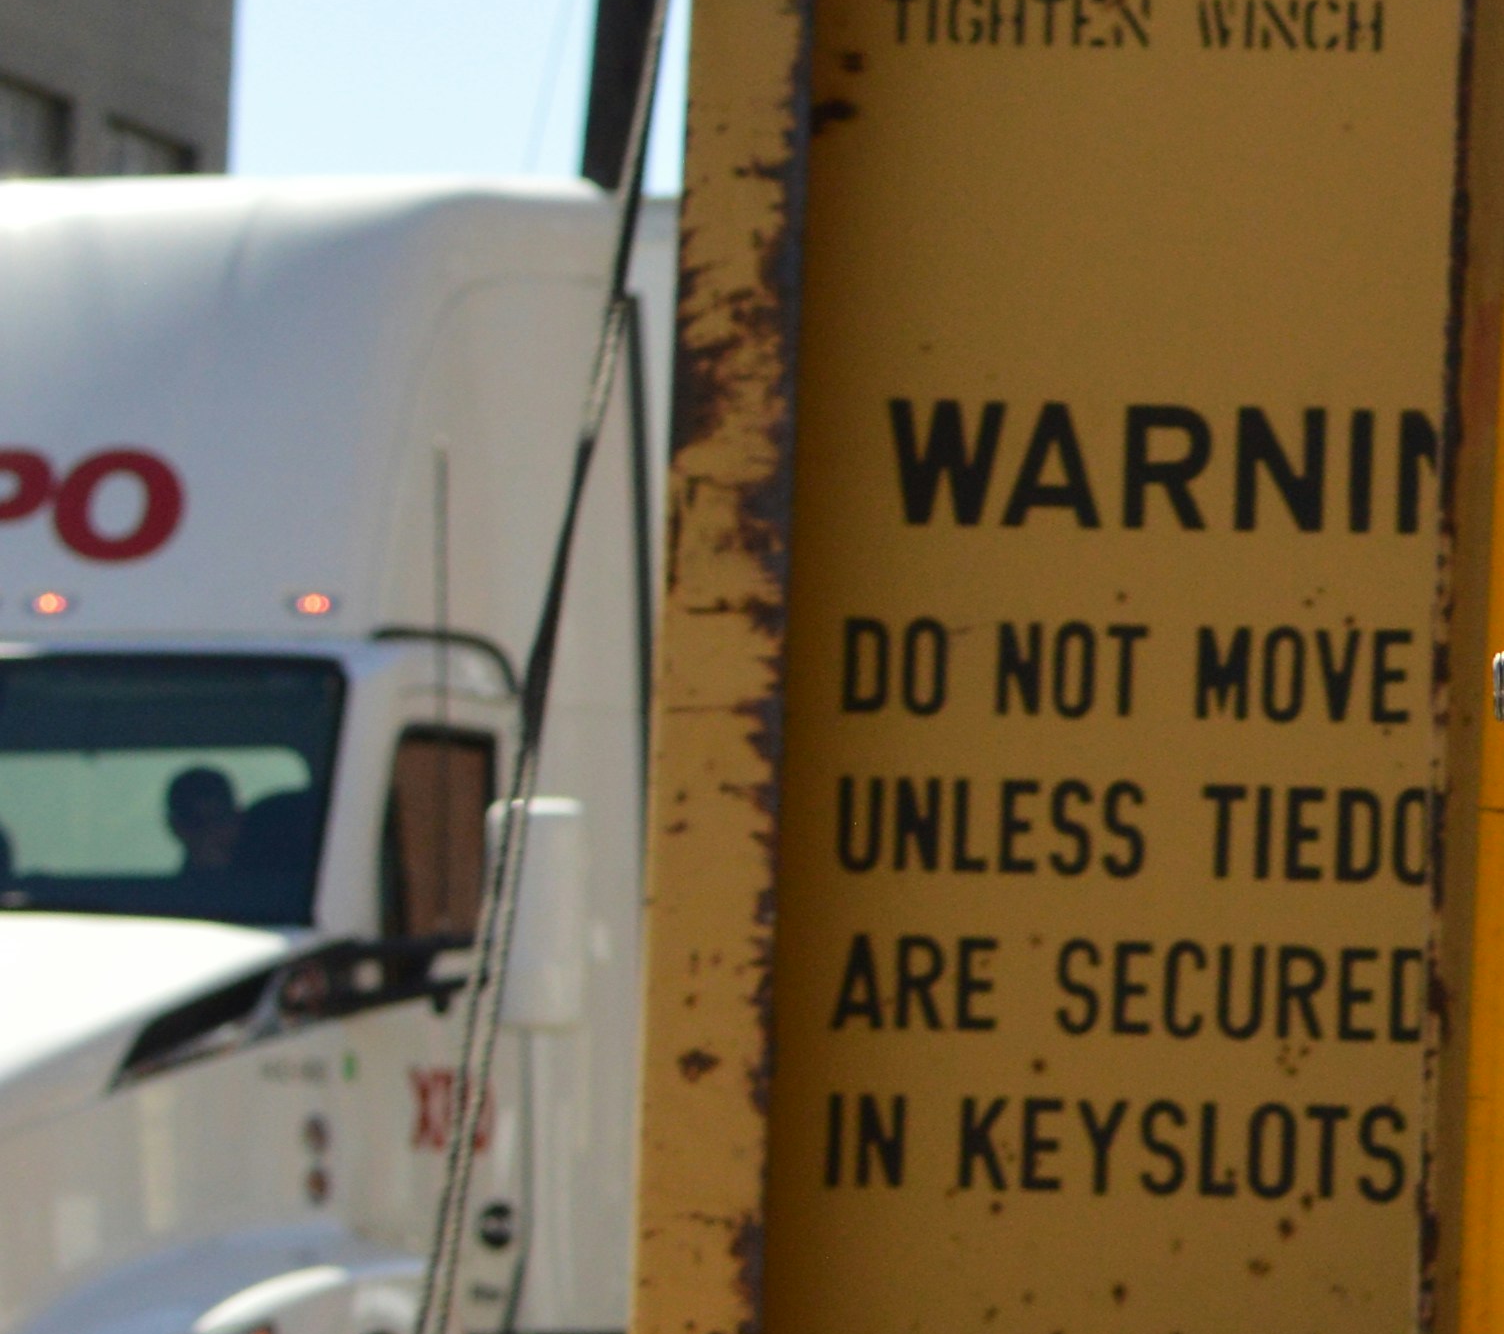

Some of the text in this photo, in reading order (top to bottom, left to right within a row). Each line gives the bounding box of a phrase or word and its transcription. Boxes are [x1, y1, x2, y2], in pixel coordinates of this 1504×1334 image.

[839, 615, 1413, 725] DO NOT MOVE
[833, 774, 1428, 889] UNLESS TIEDO
[829, 932, 1424, 1047] ARE SECURED
[822, 1092, 1407, 1208] IN KEYSLOTS
